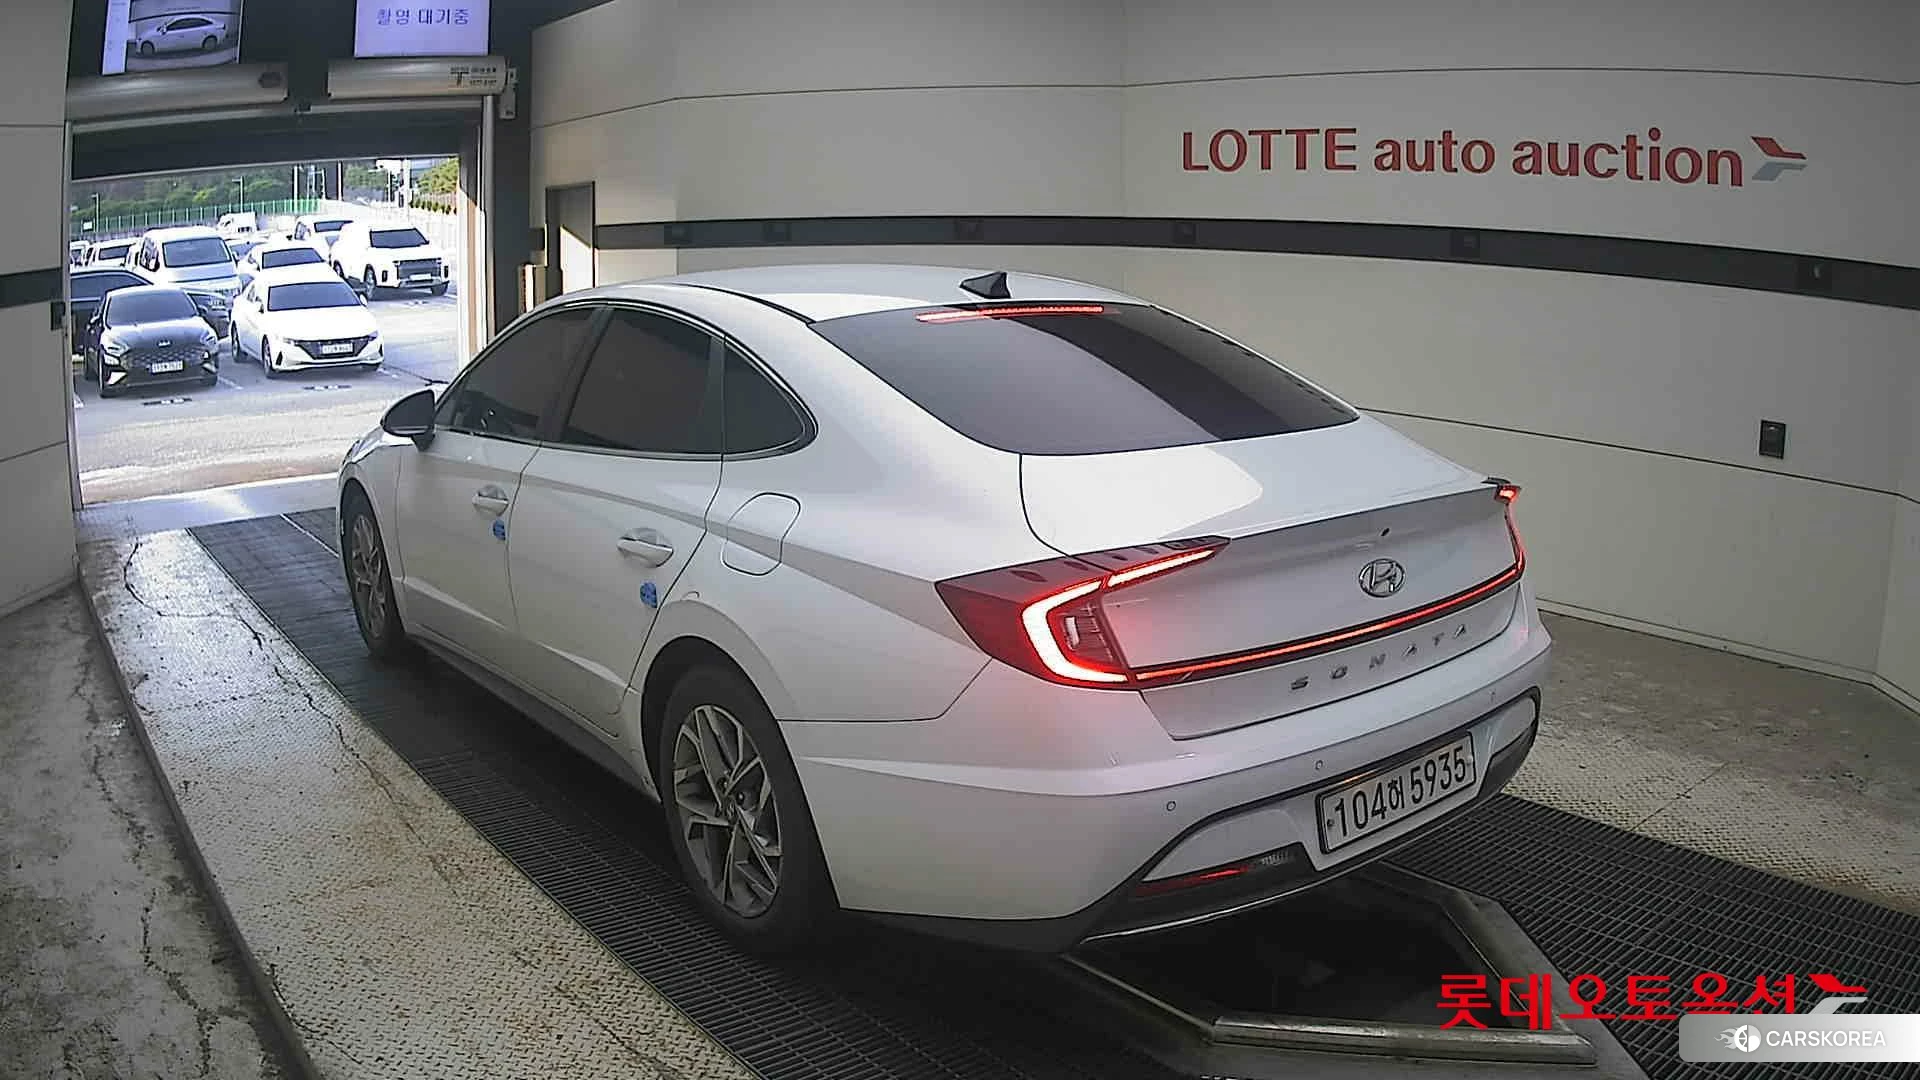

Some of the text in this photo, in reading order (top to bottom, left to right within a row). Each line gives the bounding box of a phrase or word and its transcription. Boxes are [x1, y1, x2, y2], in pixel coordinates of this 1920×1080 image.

[417, 8, 469, 26] 대기중
[1182, 127, 1744, 187] LOTTE auto auction
[1289, 623, 1469, 691] SONATA
